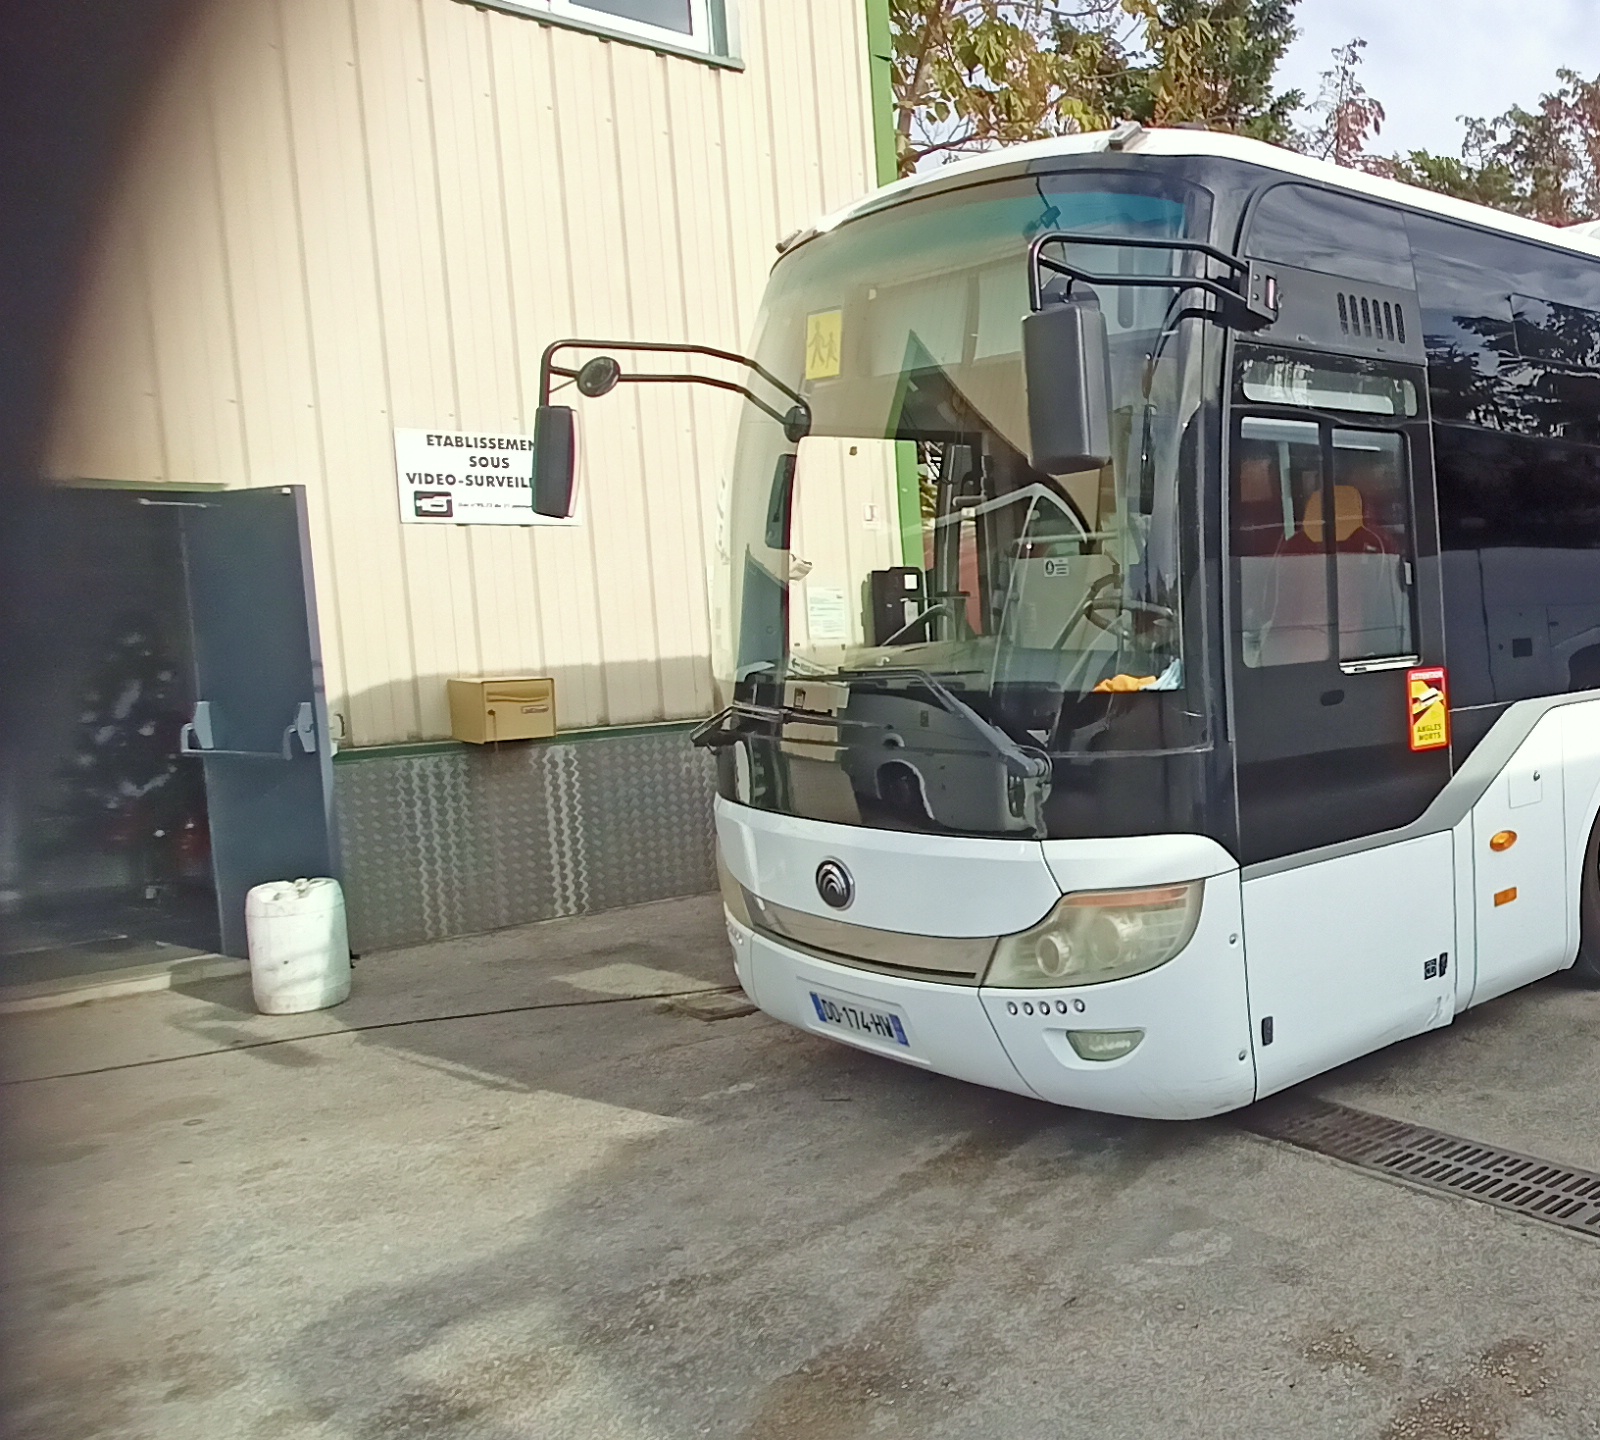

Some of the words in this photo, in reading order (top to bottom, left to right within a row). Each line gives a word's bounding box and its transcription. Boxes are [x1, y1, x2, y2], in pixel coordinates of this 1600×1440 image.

[469, 456, 510, 469] SOUS
[1417, 723, 1442, 733] ANGLES
[1418, 731, 1441, 741] MORTS
